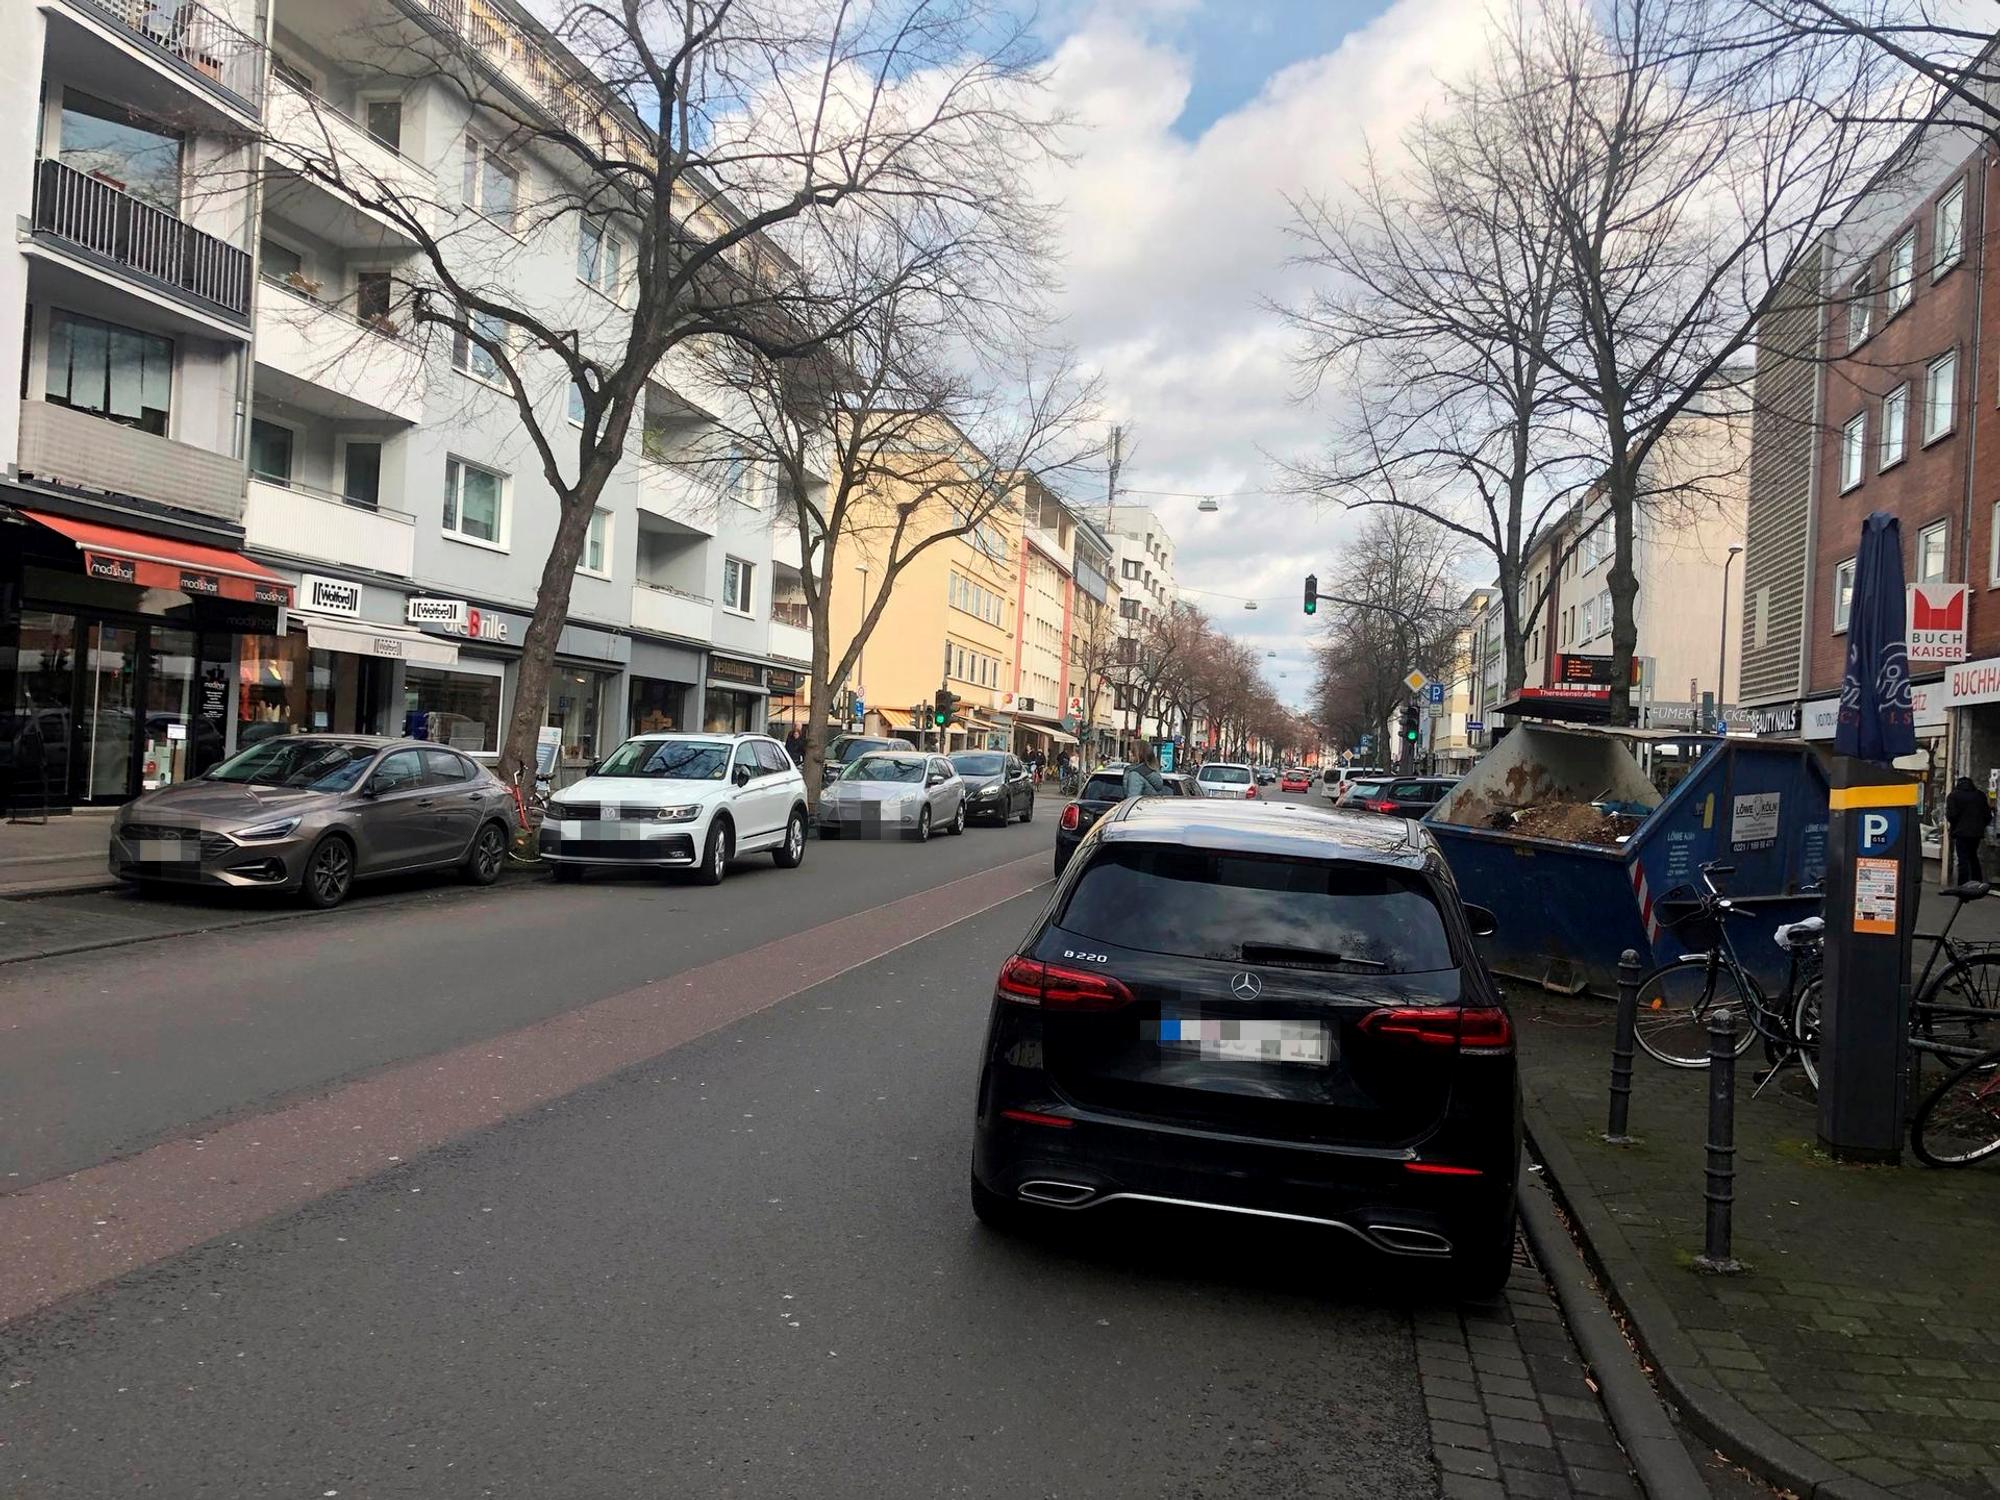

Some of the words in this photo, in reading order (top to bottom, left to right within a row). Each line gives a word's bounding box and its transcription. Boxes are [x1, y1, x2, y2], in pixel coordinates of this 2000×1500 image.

[320, 587, 350, 605] Wolford
[420, 606, 449, 617] Wolford
[1912, 633, 1963, 644] BUCH
[1912, 646, 1962, 658] KAISER
[1953, 667, 2000, 697] BUCHH
[1539, 689, 1596, 698] Theresienstraße
[1864, 814, 1888, 848] P
[1076, 951, 1108, 963] 220
